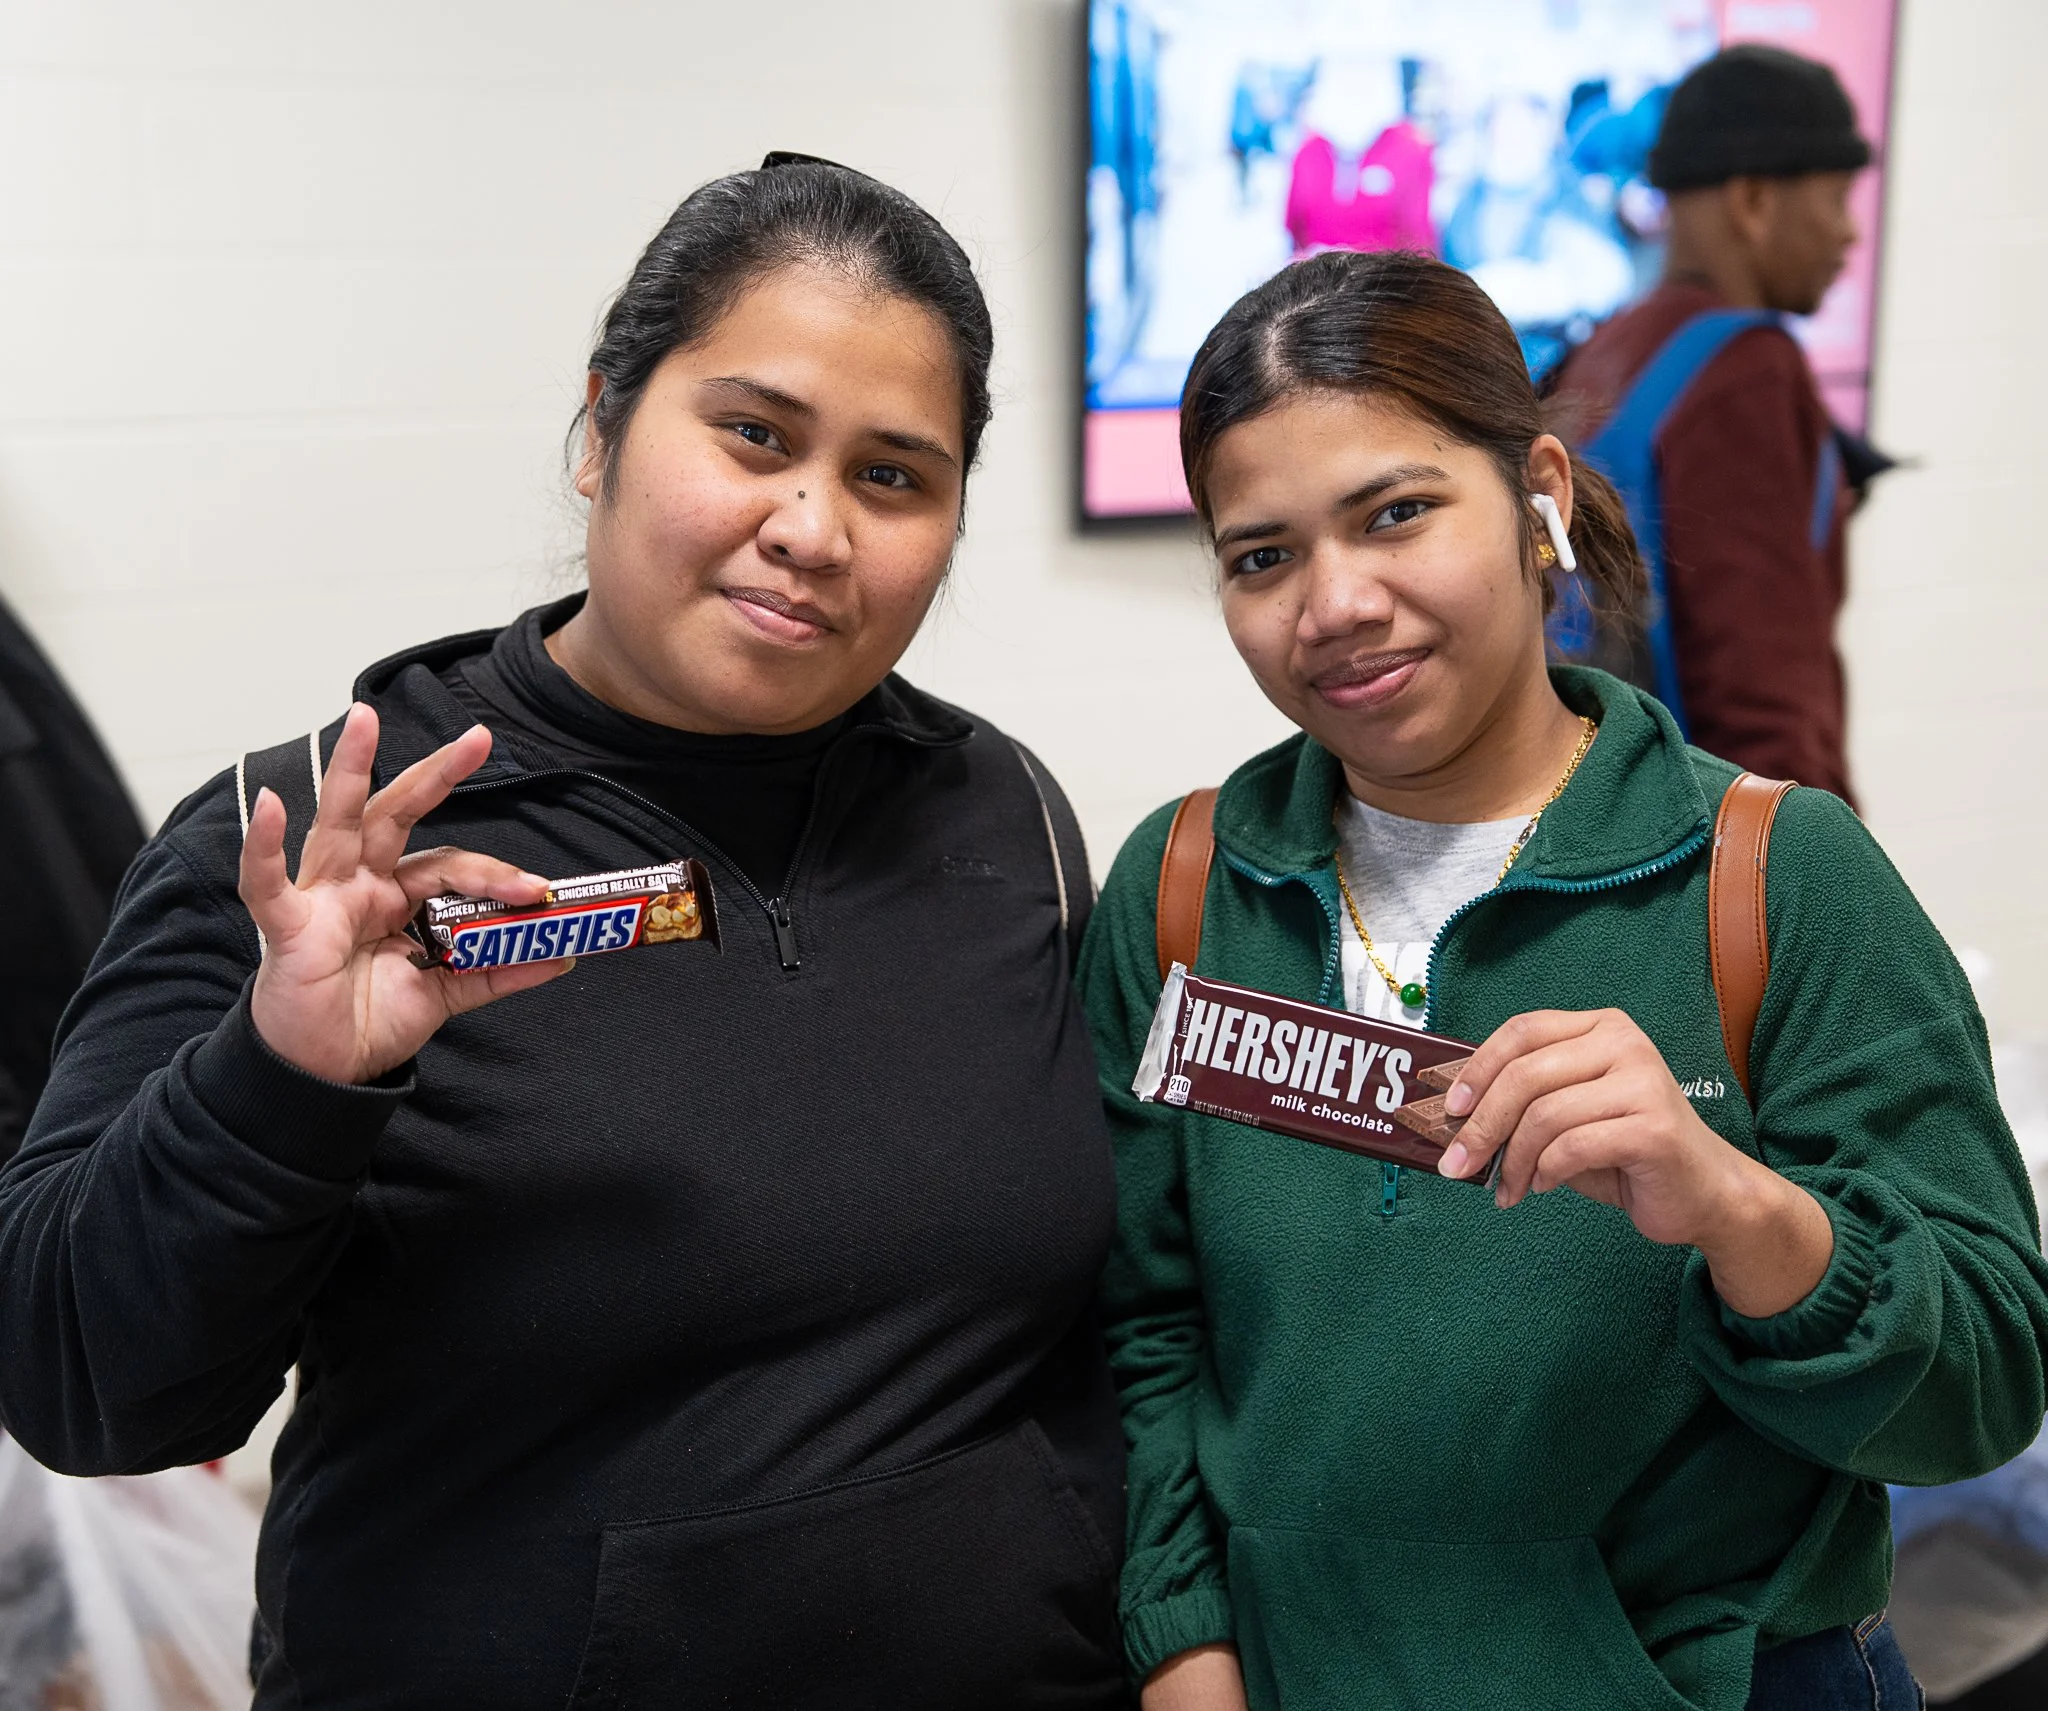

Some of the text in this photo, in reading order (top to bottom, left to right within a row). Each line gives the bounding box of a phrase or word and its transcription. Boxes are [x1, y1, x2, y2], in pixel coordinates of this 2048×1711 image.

[558, 884, 609, 901] SNICKERS
[610, 876, 645, 893] REALLY
[436, 900, 505, 921] PACKED WITH
[453, 908, 636, 969] SATISFIES
[1182, 1013, 1191, 1034] SINCE
[1181, 998, 1412, 1113] HERSHEY'S
[1170, 1078, 1189, 1093] 210
[1194, 1100, 1207, 1112] NET
[1207, 1103, 1218, 1115] WT
[1232, 1110, 1241, 1121] OZ
[1271, 1094, 1308, 1113] milk
[1311, 1103, 1394, 1134] chocolate
